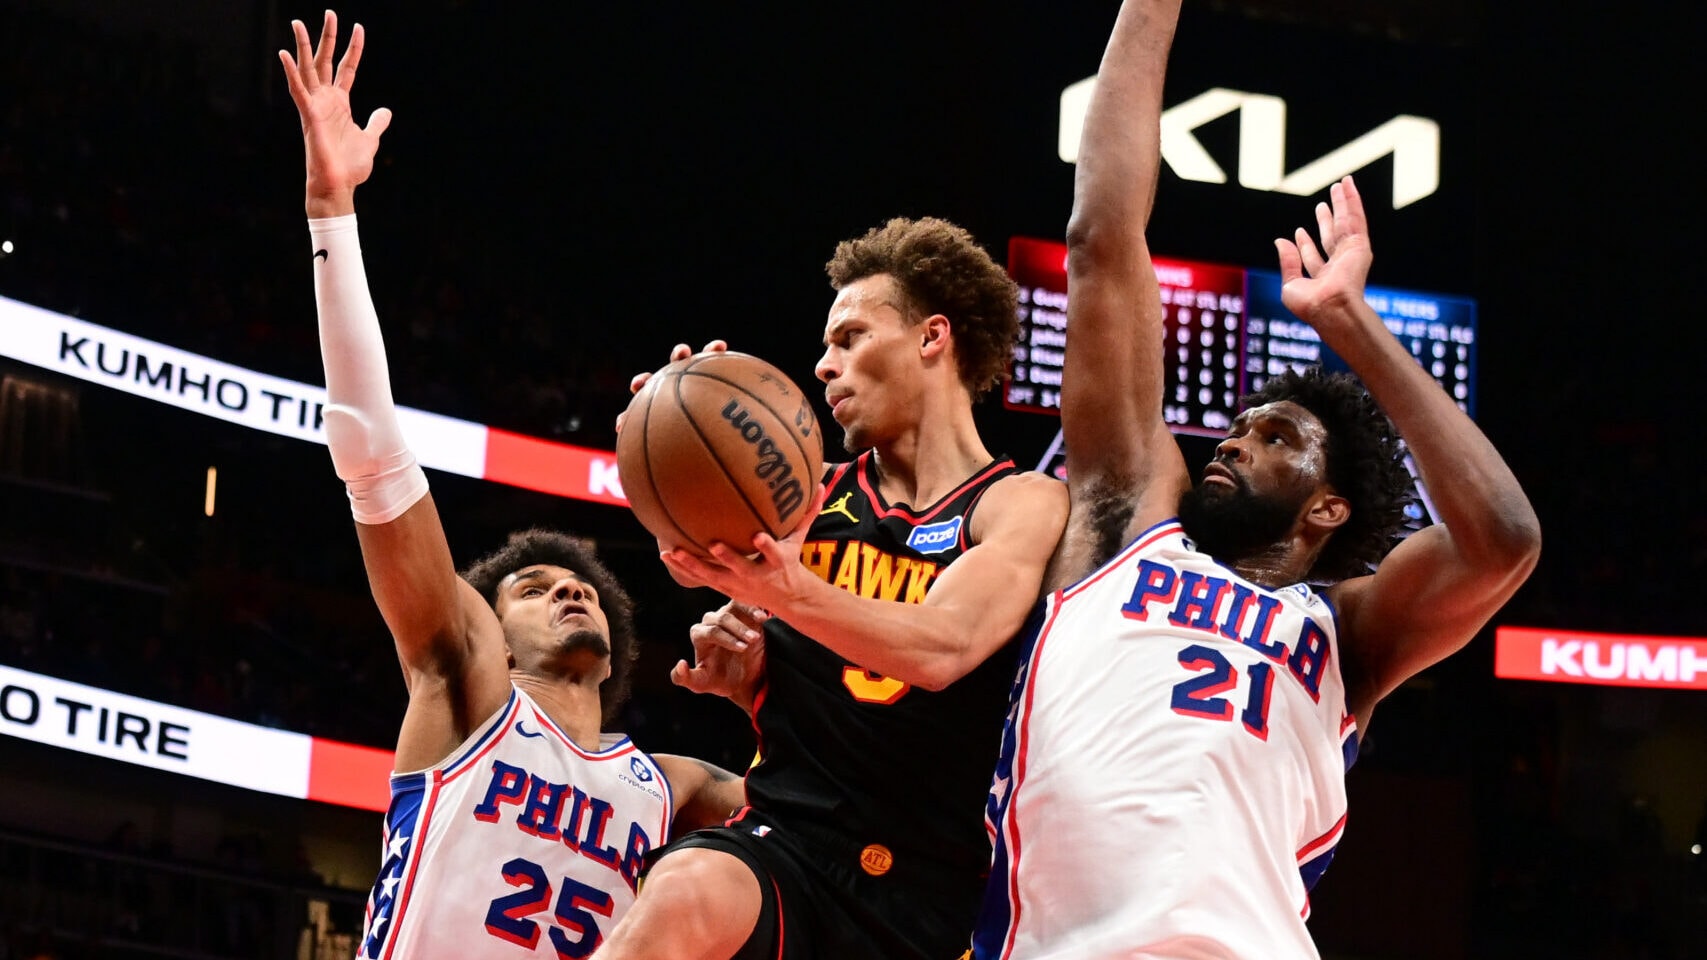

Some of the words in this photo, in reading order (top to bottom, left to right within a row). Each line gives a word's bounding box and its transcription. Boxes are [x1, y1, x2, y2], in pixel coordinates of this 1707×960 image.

[59, 331, 248, 411] KUMHO
[260, 388, 324, 430] TI
[721, 400, 804, 523] Wilson
[800, 540, 943, 605] HAWK
[913, 526, 955, 546] paze
[1121, 559, 1330, 705] PHILA
[1540, 638, 1707, 682] KUMH
[54, 696, 191, 761] TIRE
[1170, 644, 1275, 742] 21
[473, 760, 651, 900] PHILA
[863, 850, 887, 869] ATL
[485, 857, 615, 960] 25
